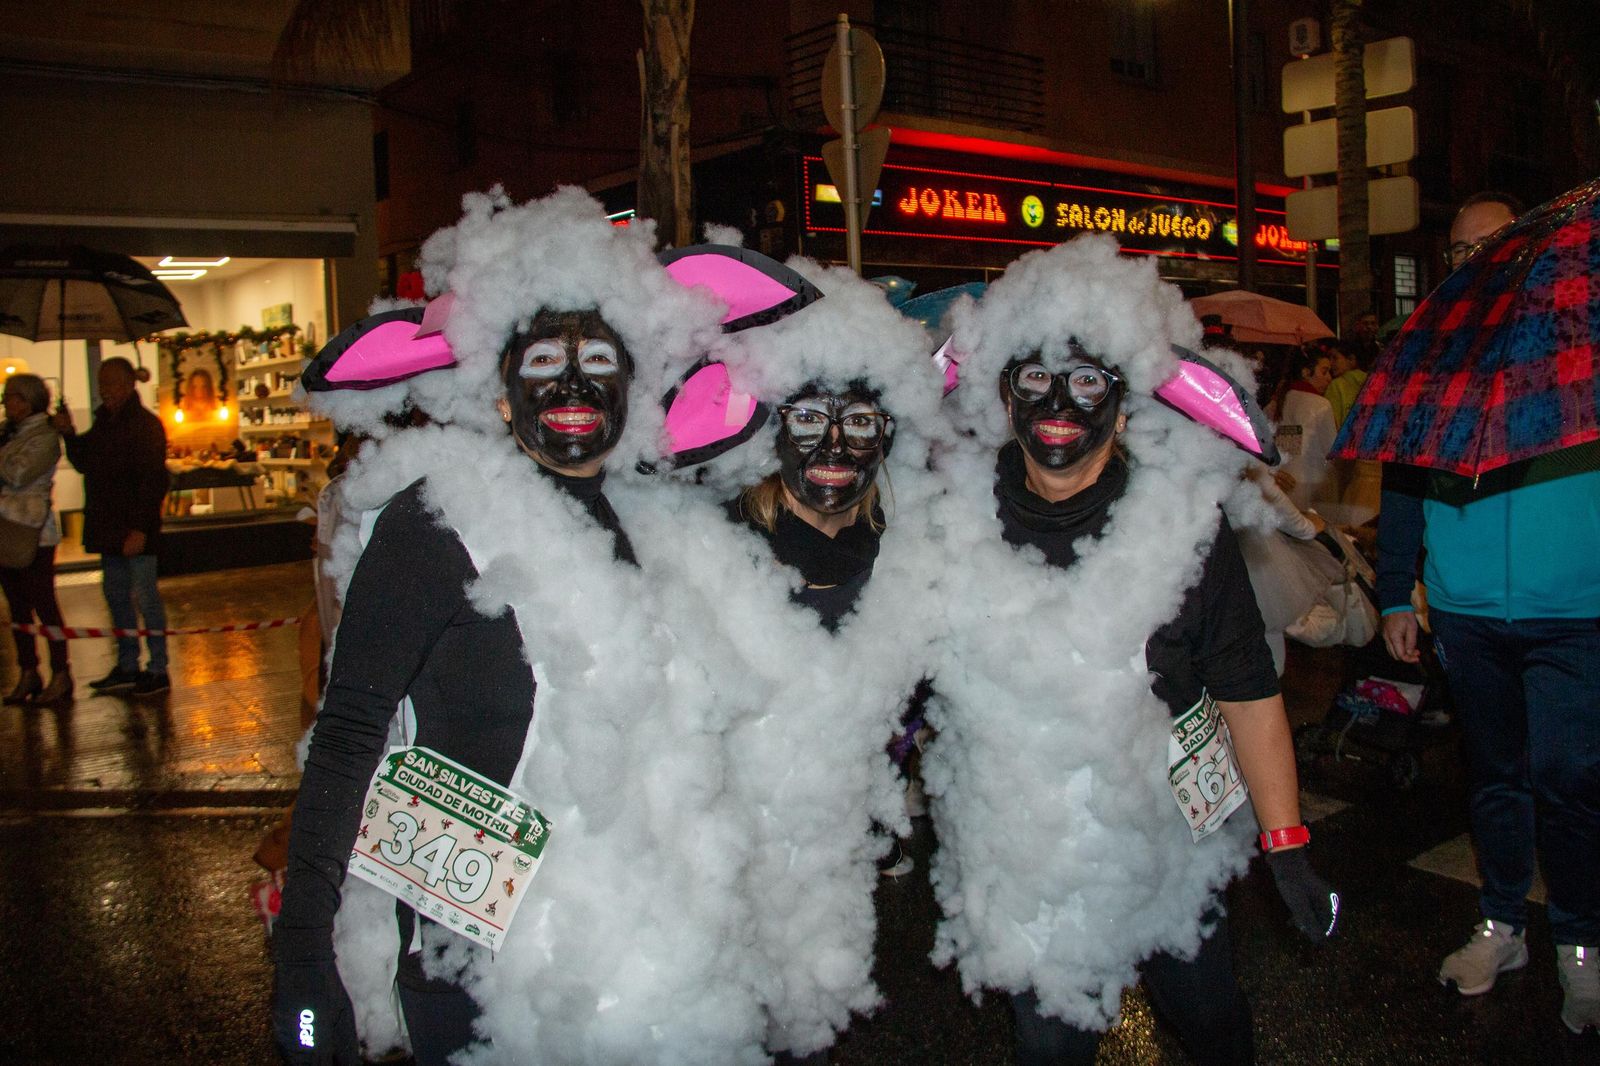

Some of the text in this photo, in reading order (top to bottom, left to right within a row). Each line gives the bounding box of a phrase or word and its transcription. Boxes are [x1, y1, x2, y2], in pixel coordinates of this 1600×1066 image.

[899, 187, 1007, 223] JOKER
[1056, 202, 1211, 240] SALON de JUEGO
[398, 770, 443, 799] CIUDAD
[443, 793, 462, 809] DE
[462, 803, 513, 836] MOTRIL
[404, 751, 527, 823] SAN SILVESTRE
[528, 820, 544, 837] 19
[378, 810, 494, 904] 349
